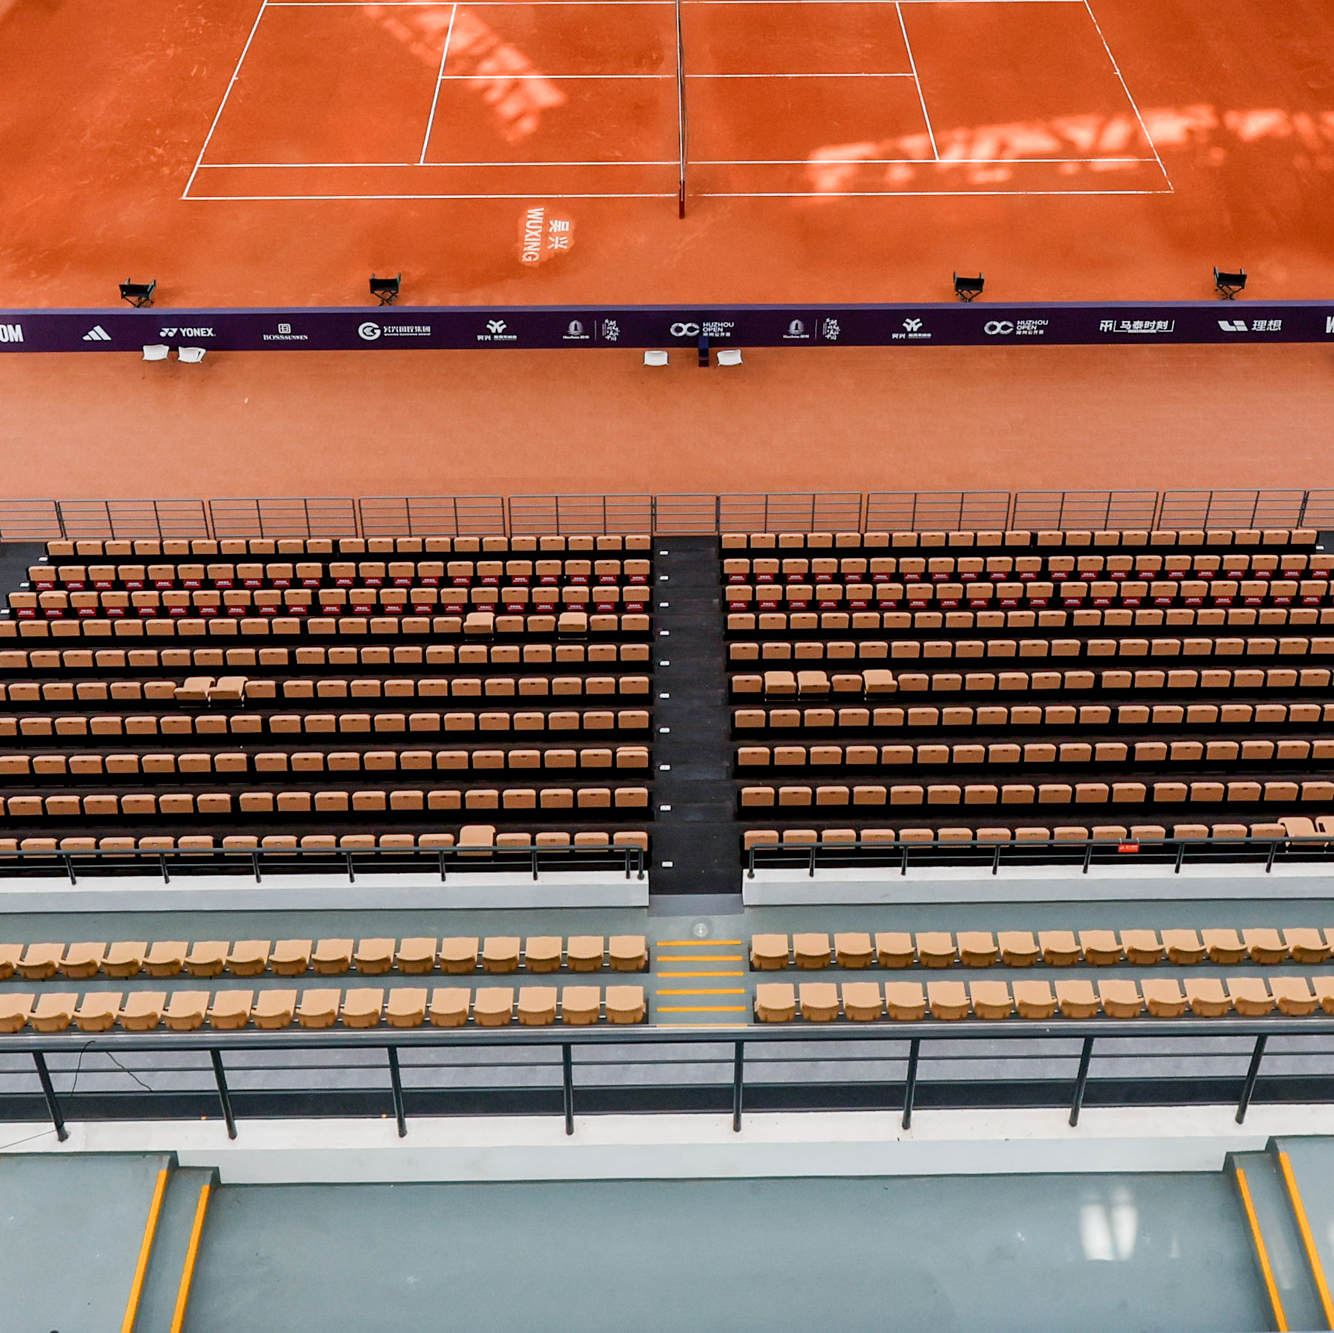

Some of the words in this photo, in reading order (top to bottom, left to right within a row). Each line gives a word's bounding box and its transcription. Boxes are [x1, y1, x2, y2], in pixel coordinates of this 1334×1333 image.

[522, 207, 544, 262] WUXING
[547, 219, 570, 249] 吴兴
[1119, 320, 1168, 331] 马泰时刻
[1251, 320, 1282, 332] 理想
[180, 327, 214, 337] YONEX
